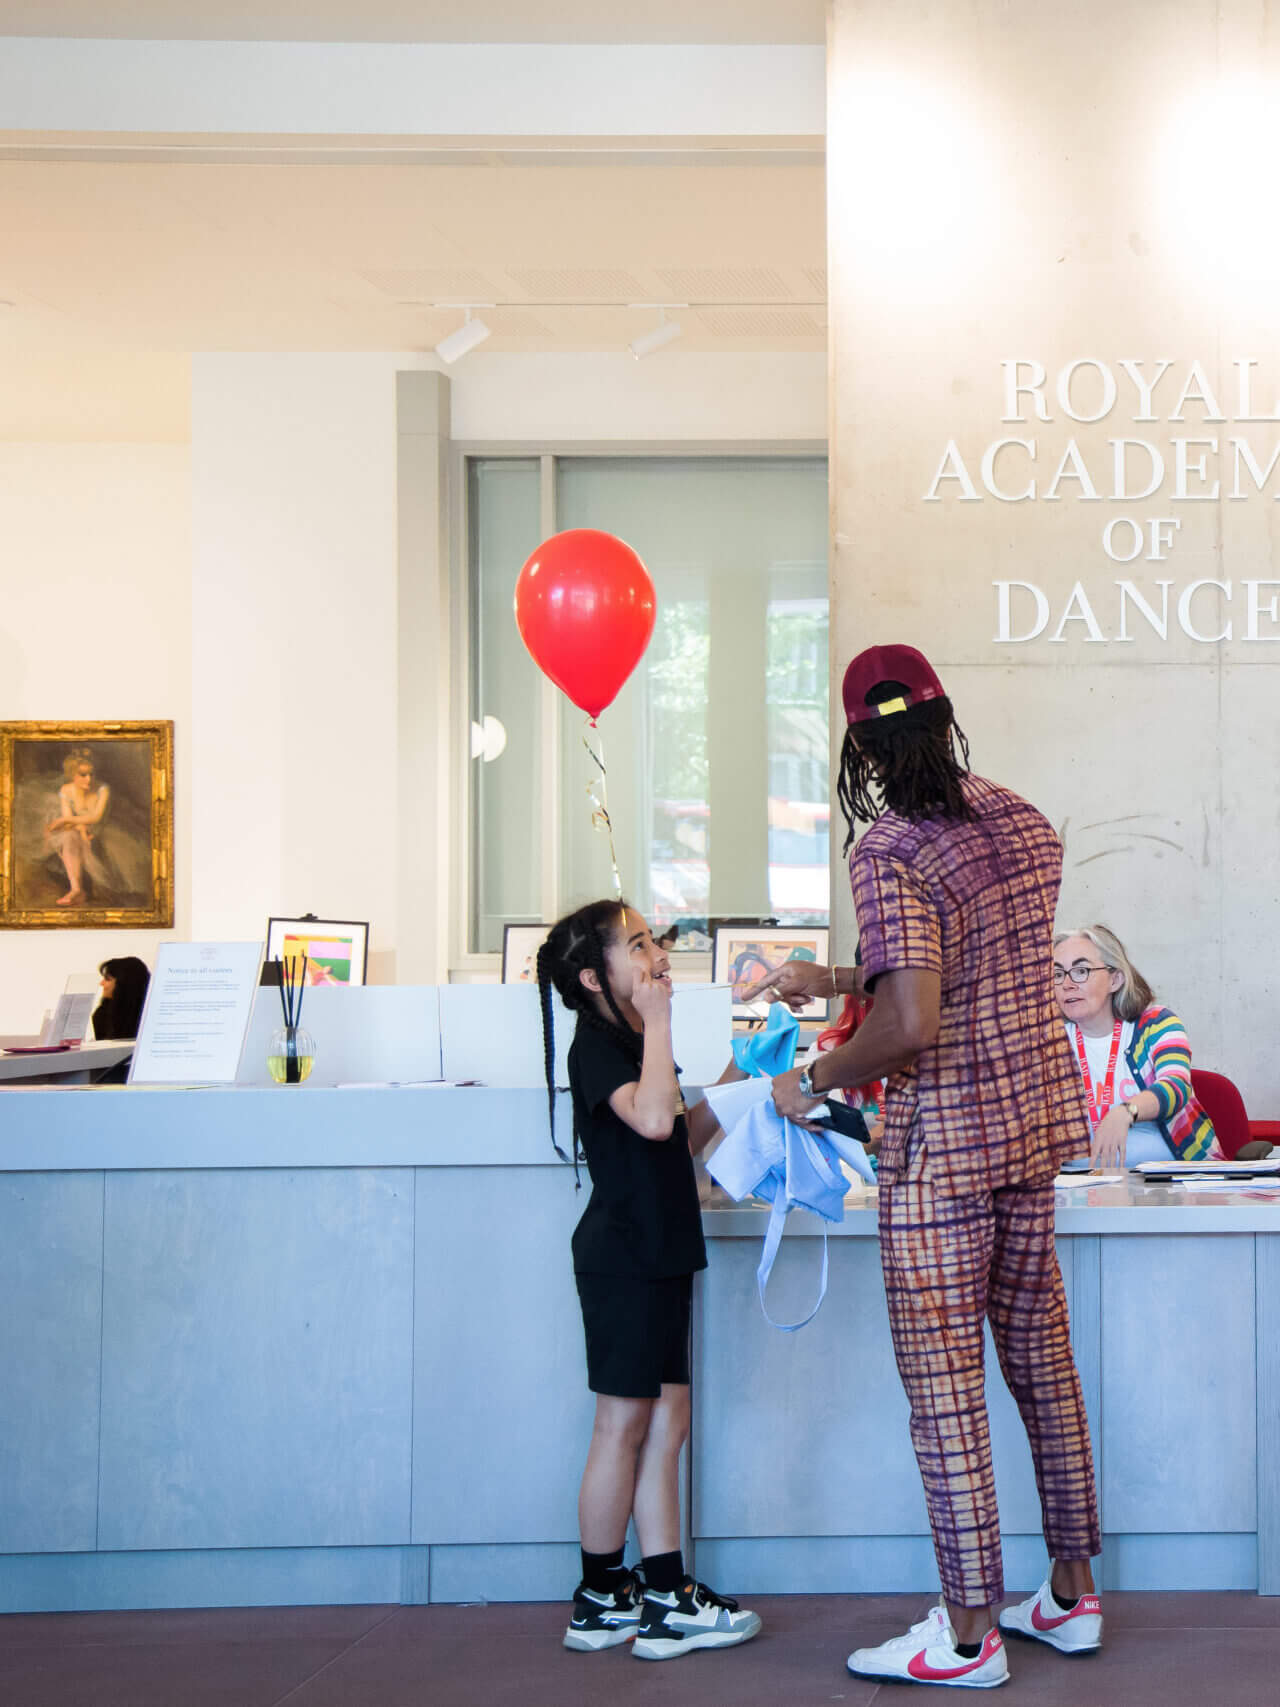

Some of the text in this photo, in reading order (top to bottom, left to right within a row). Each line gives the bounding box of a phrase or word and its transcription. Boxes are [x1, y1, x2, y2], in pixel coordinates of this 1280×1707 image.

[1102, 518, 1181, 562] OF
[1112, 1023, 1122, 1041] RAD
[1079, 1057, 1089, 1077] RAD
[1106, 1054, 1117, 1072] RAD
[1085, 1088, 1096, 1108] RAD
[1102, 1085, 1112, 1105] RAD
[1084, 1600, 1100, 1609] NIKE
